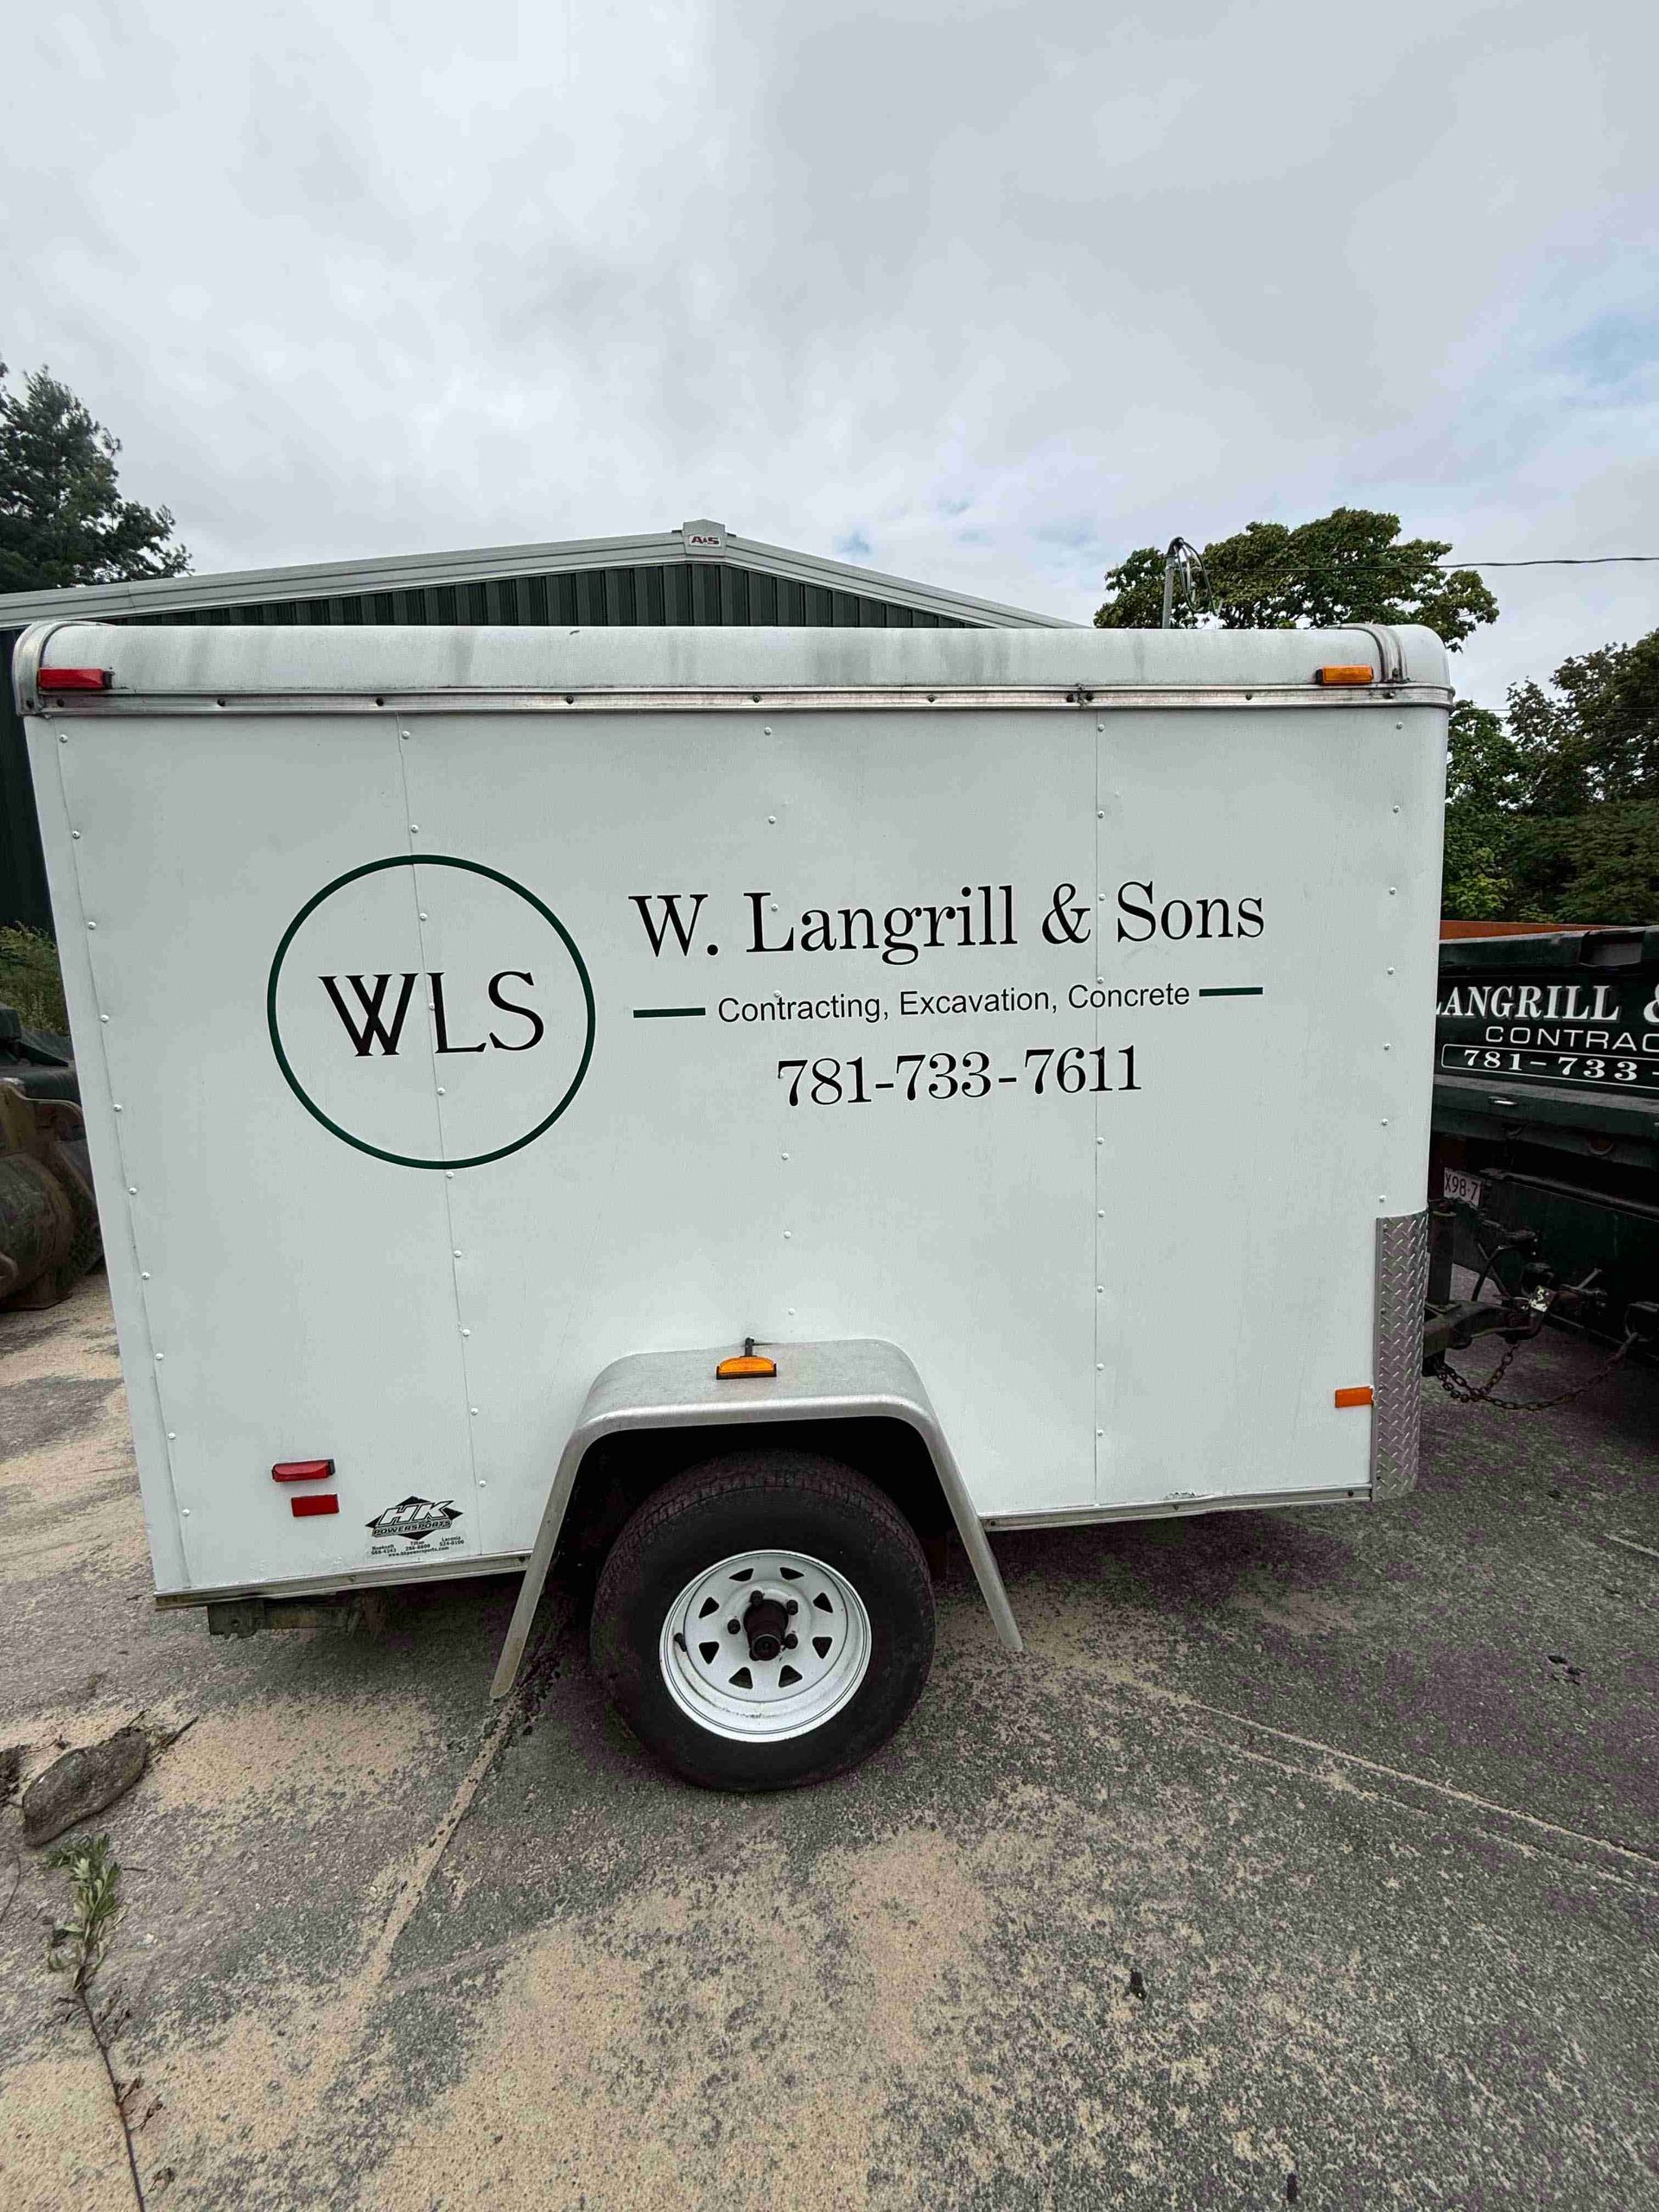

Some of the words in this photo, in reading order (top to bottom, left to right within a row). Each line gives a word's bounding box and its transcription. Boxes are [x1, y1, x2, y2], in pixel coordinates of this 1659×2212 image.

[628, 894, 719, 957] W.
[744, 885, 1018, 965] Langrill
[1041, 883, 1091, 944] &
[1117, 881, 1264, 942] Sons
[317, 970, 544, 1057] WLS
[718, 995, 889, 1023] Contracting,
[899, 987, 1058, 1015] Excavation,
[1068, 982, 1190, 1009] Concrete
[778, 1045, 1142, 1106] 781-733-7611
[373, 1520, 451, 1536] POWERSPORTS
[376, 1500, 454, 1526] HK
